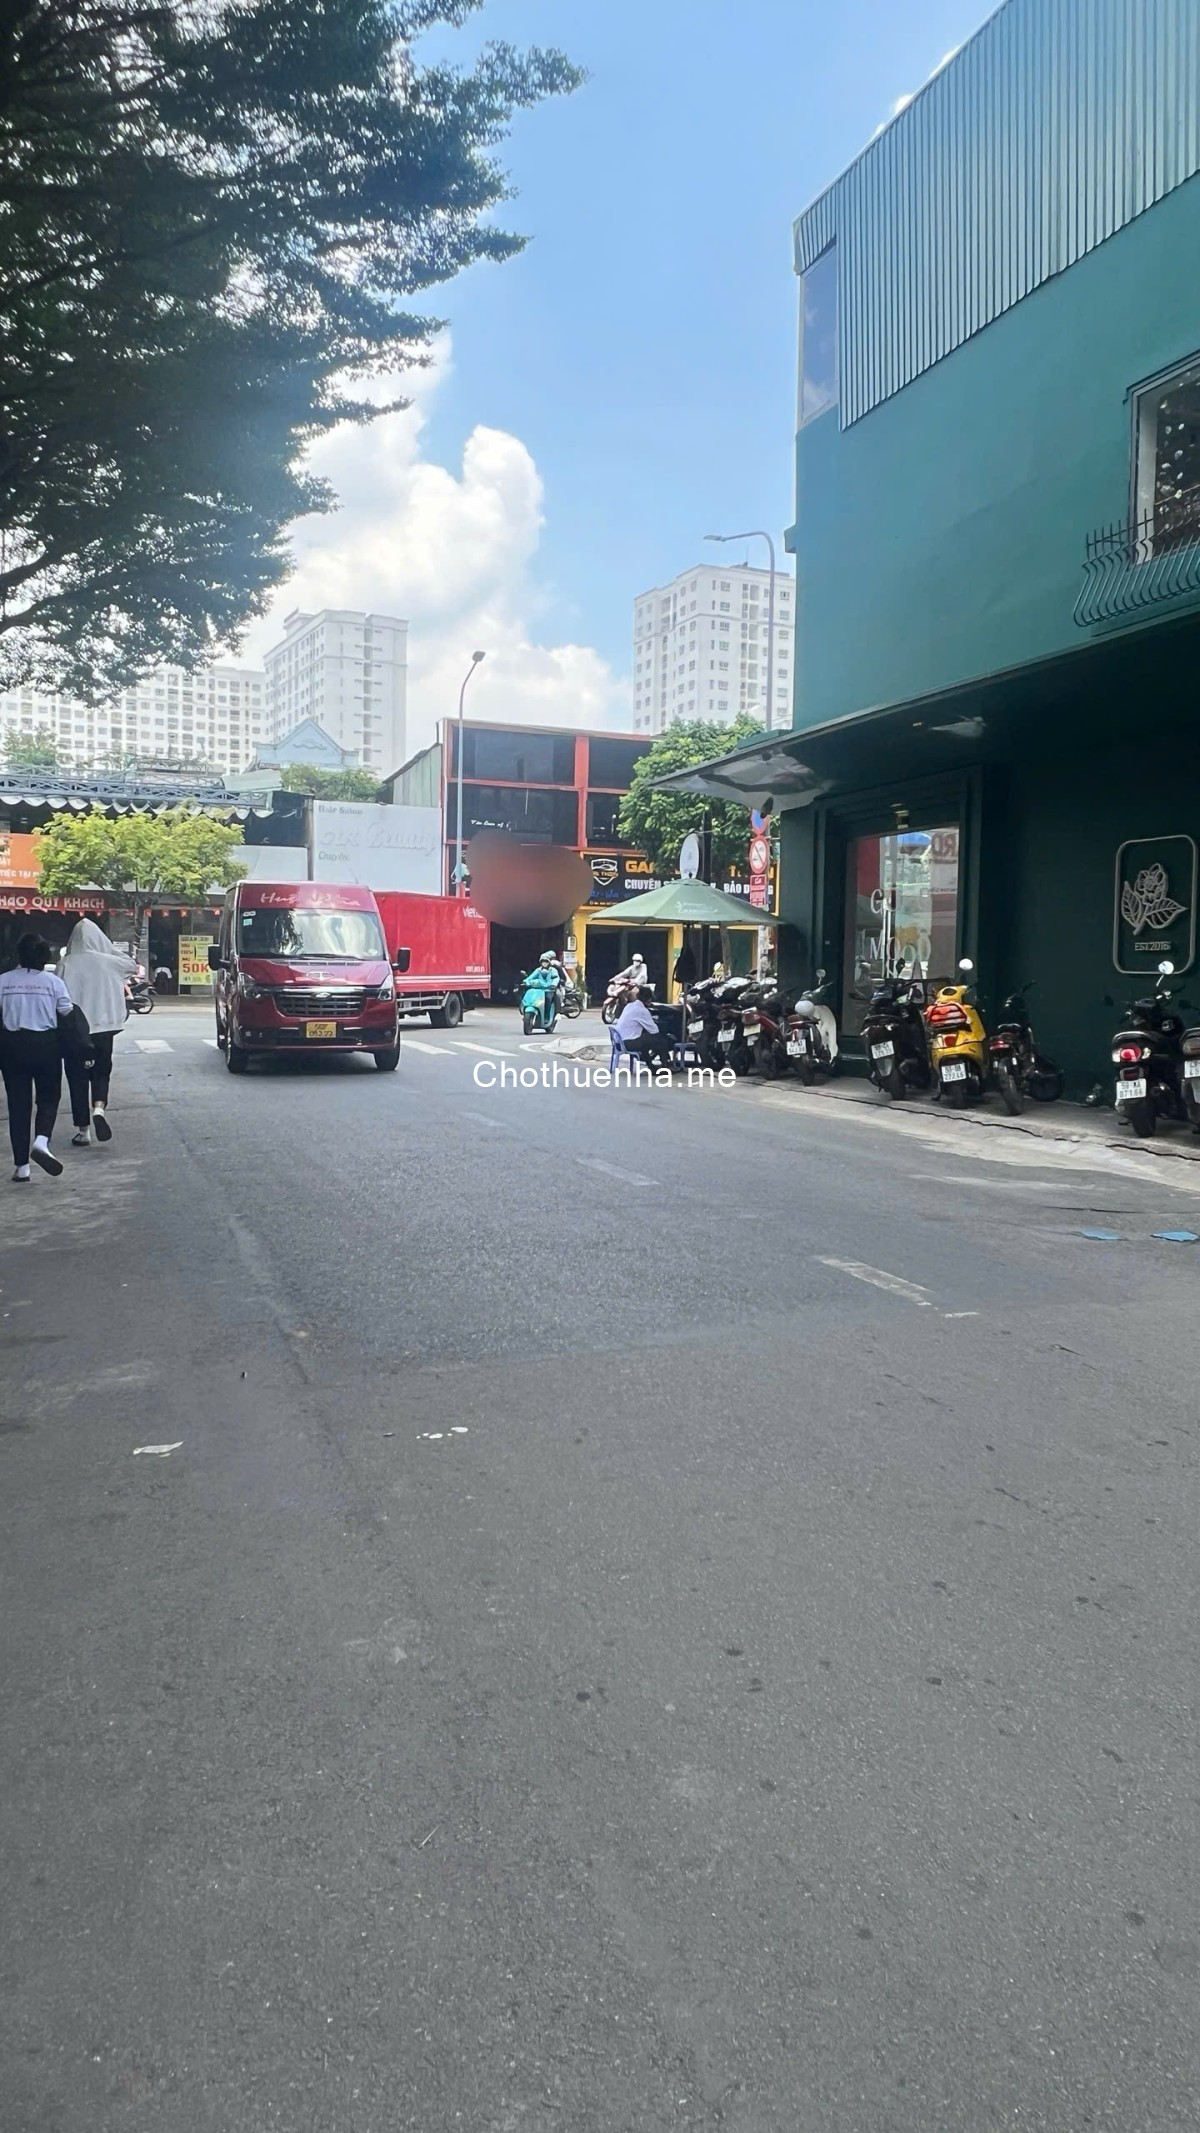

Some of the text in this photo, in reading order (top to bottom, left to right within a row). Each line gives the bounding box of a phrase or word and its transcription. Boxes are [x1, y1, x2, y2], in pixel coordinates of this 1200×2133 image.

[624, 877, 662, 890] CHUYÊN
[723, 880, 742, 894] BẢO
[182, 963, 209, 973] 50K
